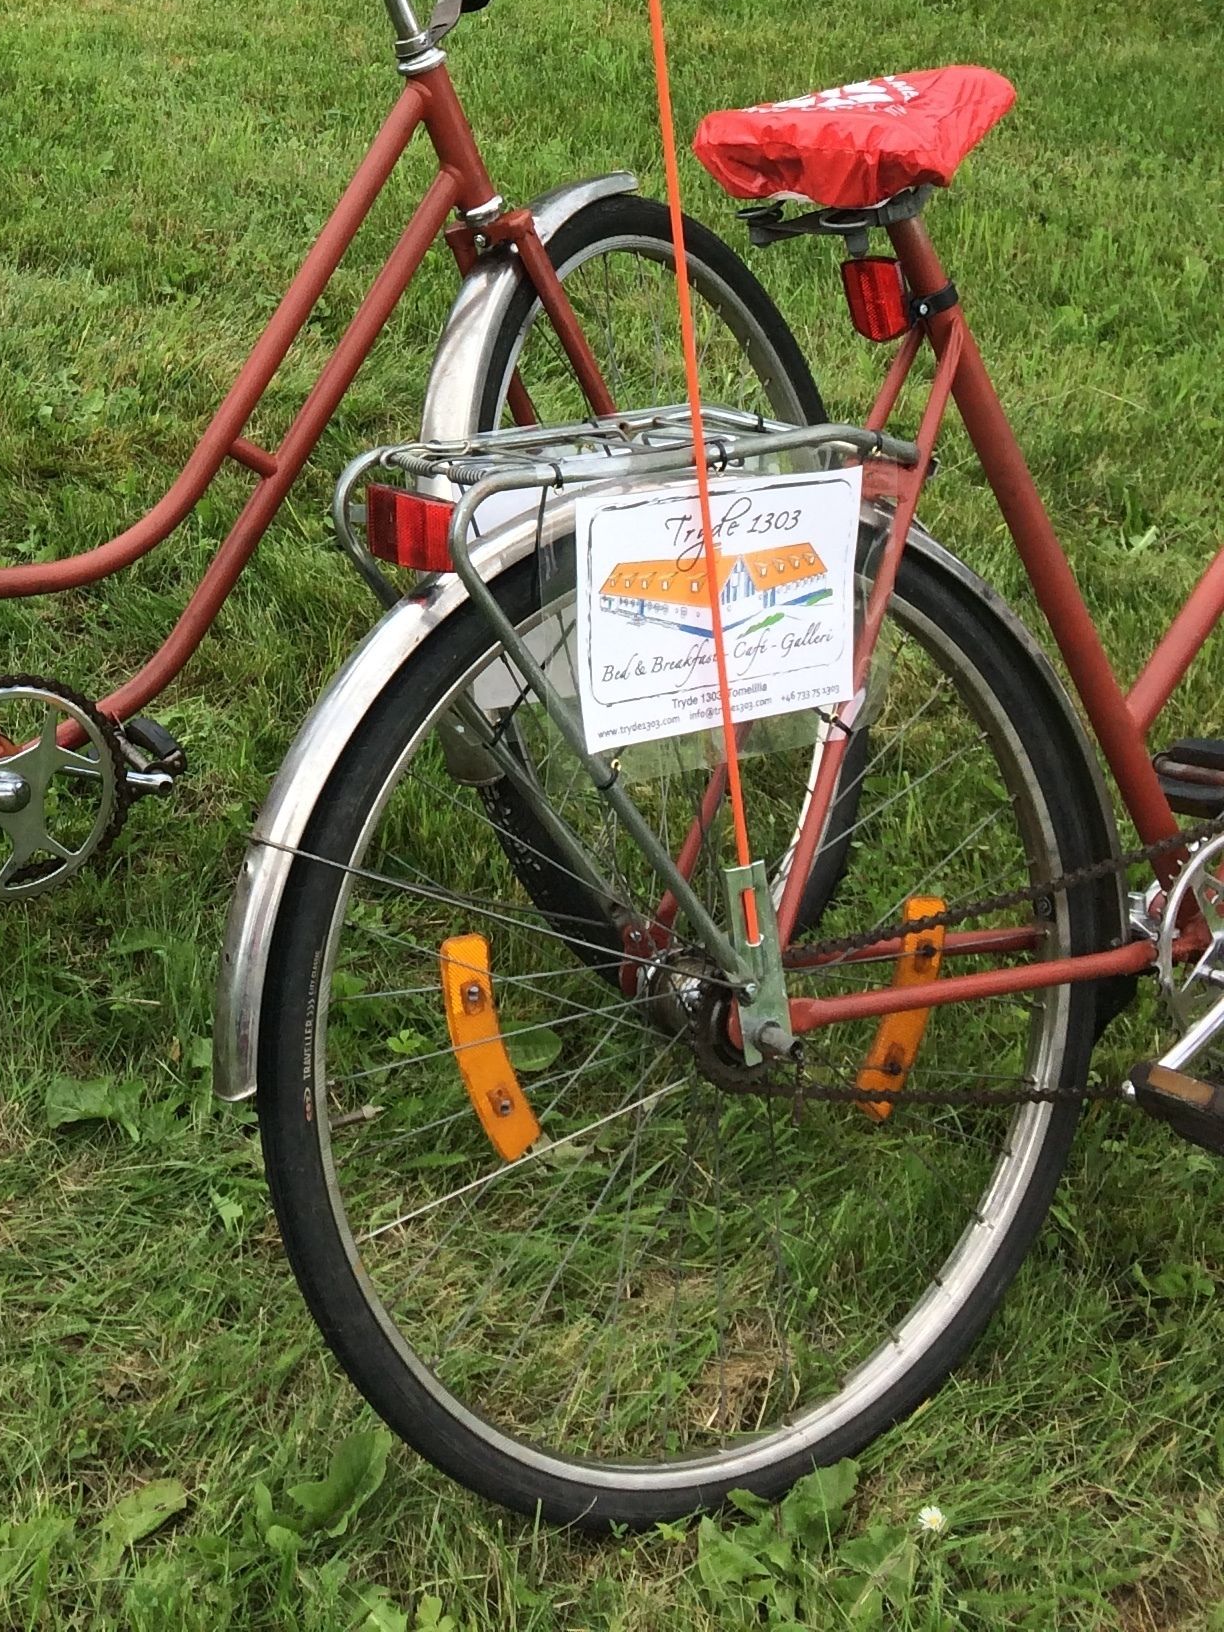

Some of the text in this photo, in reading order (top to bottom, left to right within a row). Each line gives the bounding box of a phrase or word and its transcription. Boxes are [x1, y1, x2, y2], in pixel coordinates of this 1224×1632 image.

[665, 497, 802, 572] Tryde 1303
[602, 653, 638, 683] Bed
[635, 661, 647, 676] &
[733, 628, 771, 676] Café
[781, 622, 834, 657] Galleri
[598, 715, 680, 739] www.tryde1303.com
[689, 697, 772, 720] info@tre1303.com
[796, 688, 811, 702] 733
[811, 686, 822, 698] 75
[822, 684, 840, 696] 1303
[672, 695, 698, 710] Tryde
[701, 689, 722, 704] 1303
[303, 1020, 314, 1081] TRAVELLER
